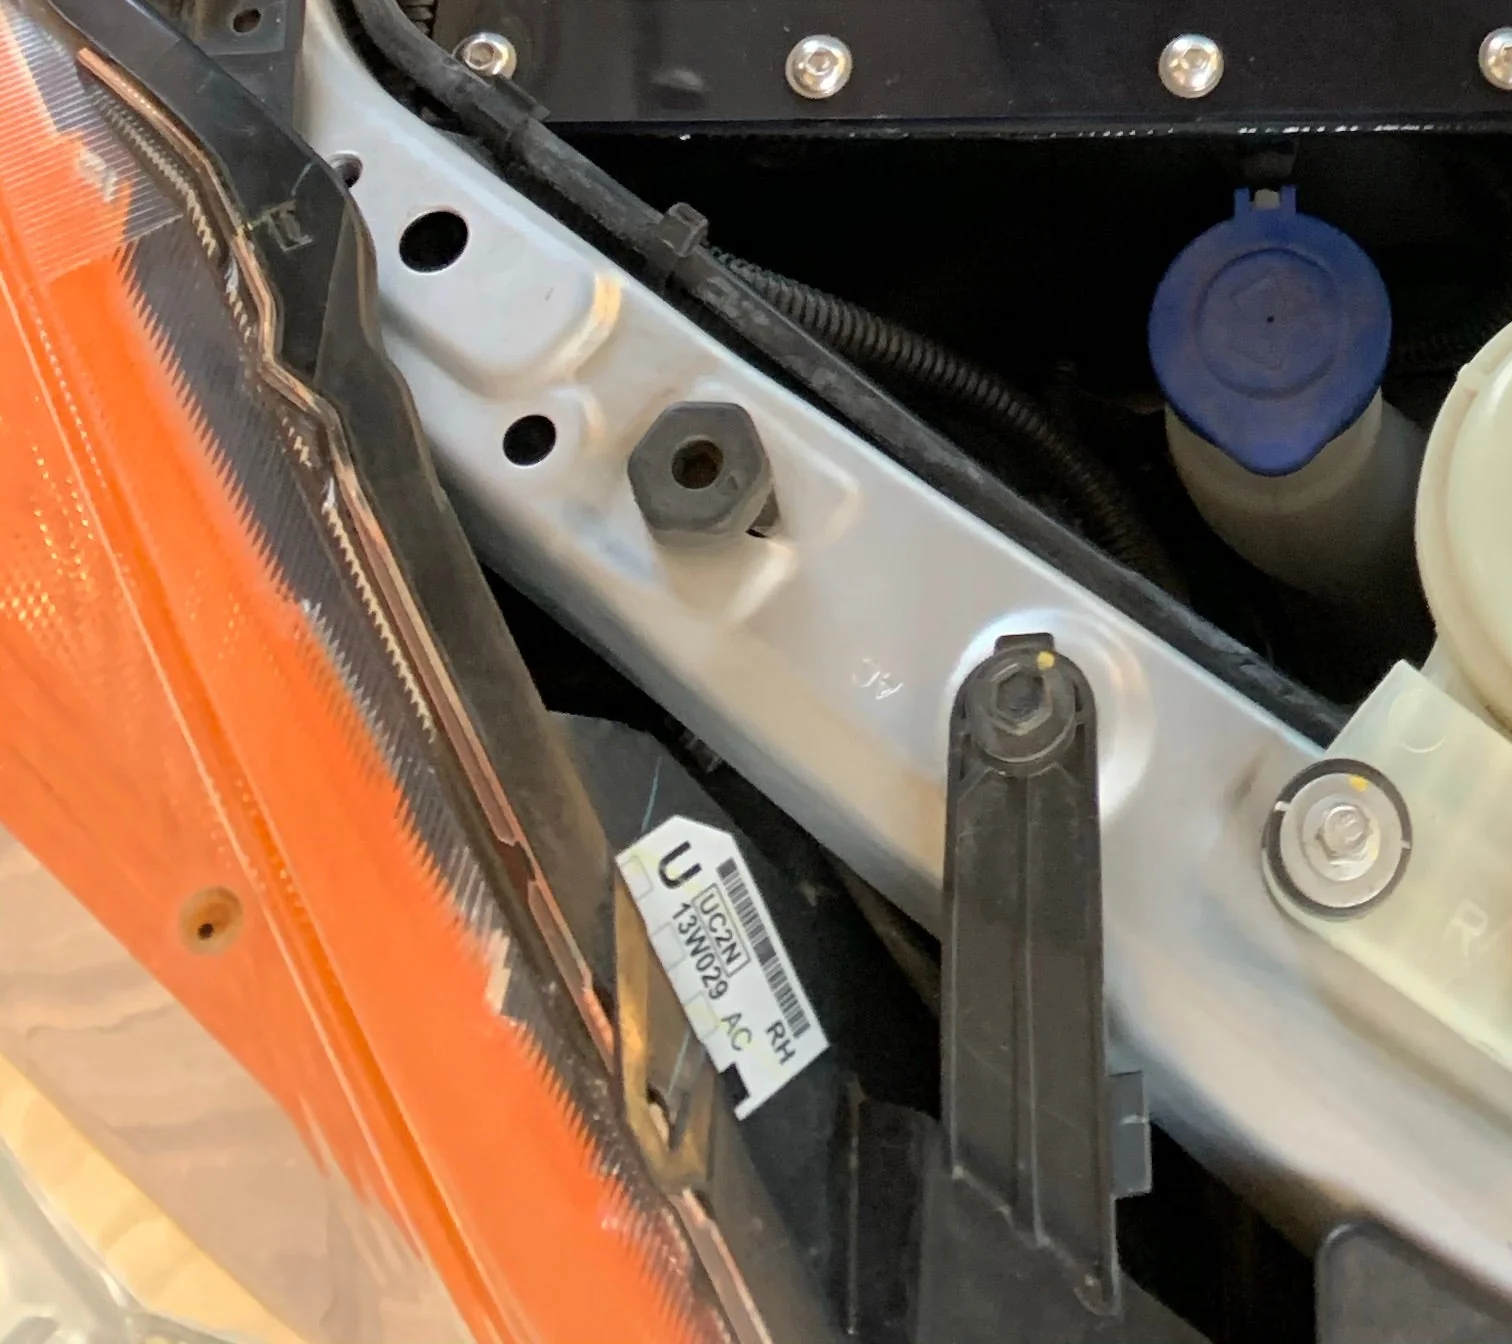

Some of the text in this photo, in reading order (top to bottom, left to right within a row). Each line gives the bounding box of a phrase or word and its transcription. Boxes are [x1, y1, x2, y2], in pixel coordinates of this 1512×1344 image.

[656, 839, 704, 891] U
[671, 902, 755, 1053] 13W029 AC
[699, 894, 798, 1066] UC2N RH
